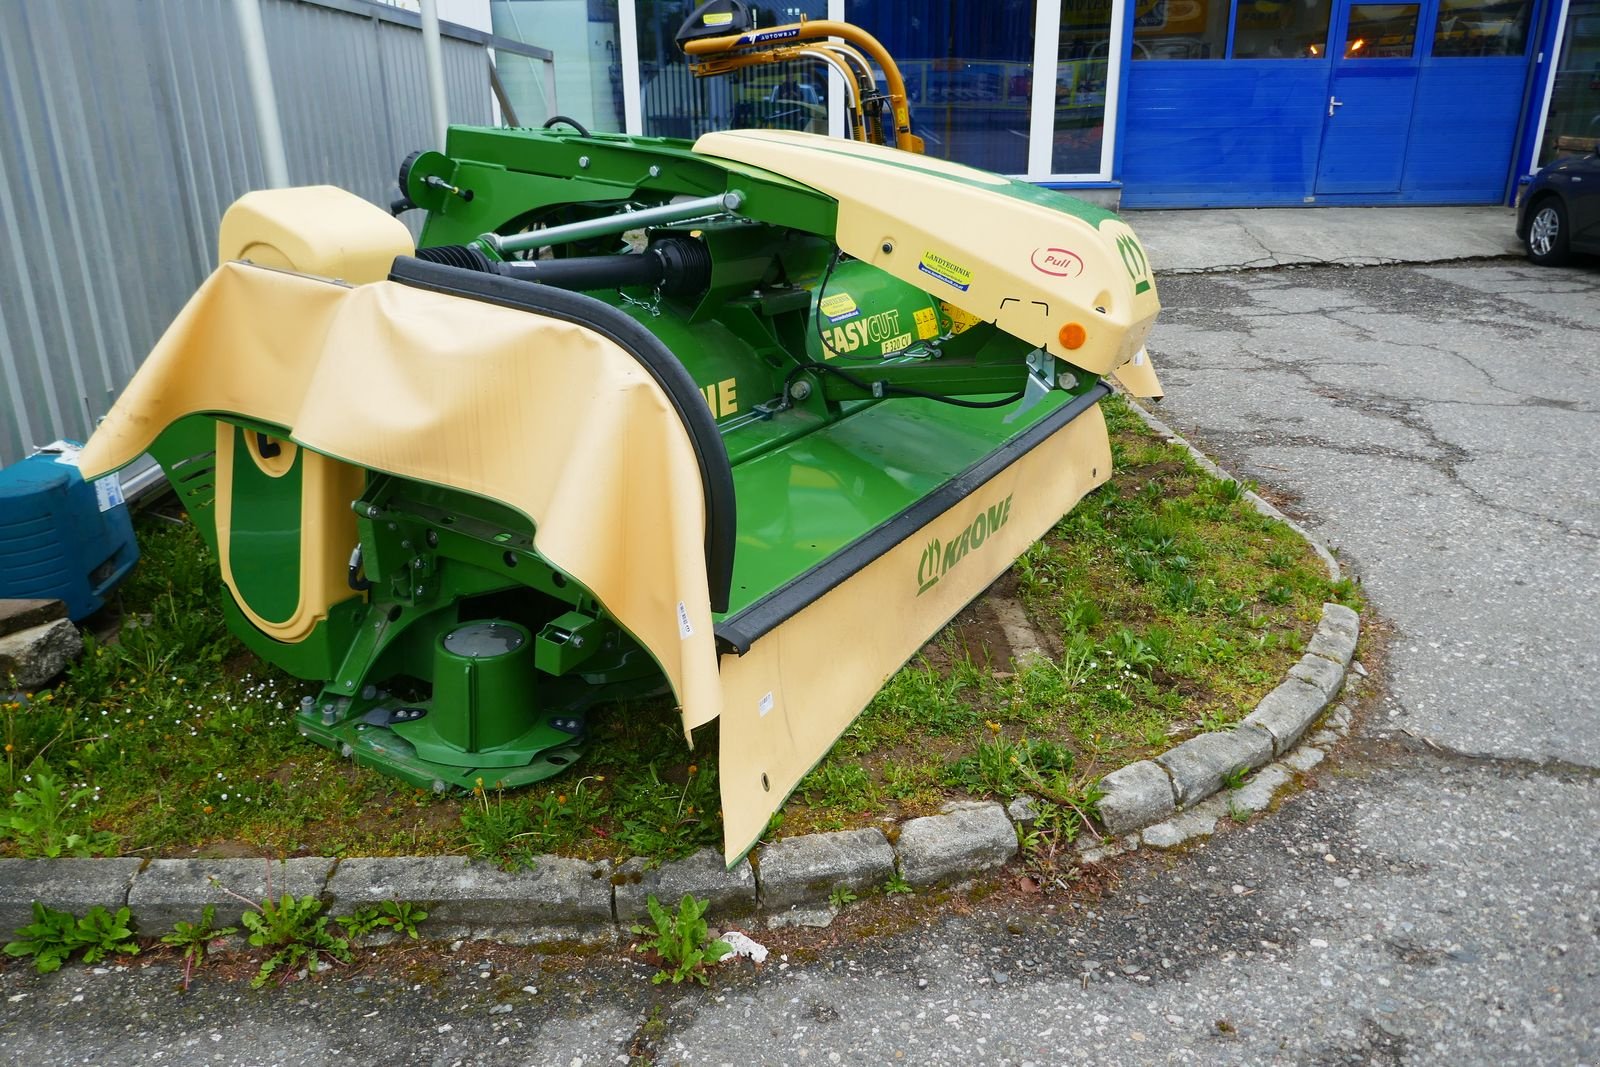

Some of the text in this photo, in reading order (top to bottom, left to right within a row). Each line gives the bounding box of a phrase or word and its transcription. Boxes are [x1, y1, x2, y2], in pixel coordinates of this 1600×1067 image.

[760, 30, 797, 41] AUTOWRAP
[925, 251, 971, 278] LANDTECHNIK
[1044, 255, 1071, 268] Pull
[821, 308, 900, 360] EASYCUT
[889, 339, 901, 351] 320
[901, 335, 910, 347] CV
[941, 491, 1014, 577] KRONE
